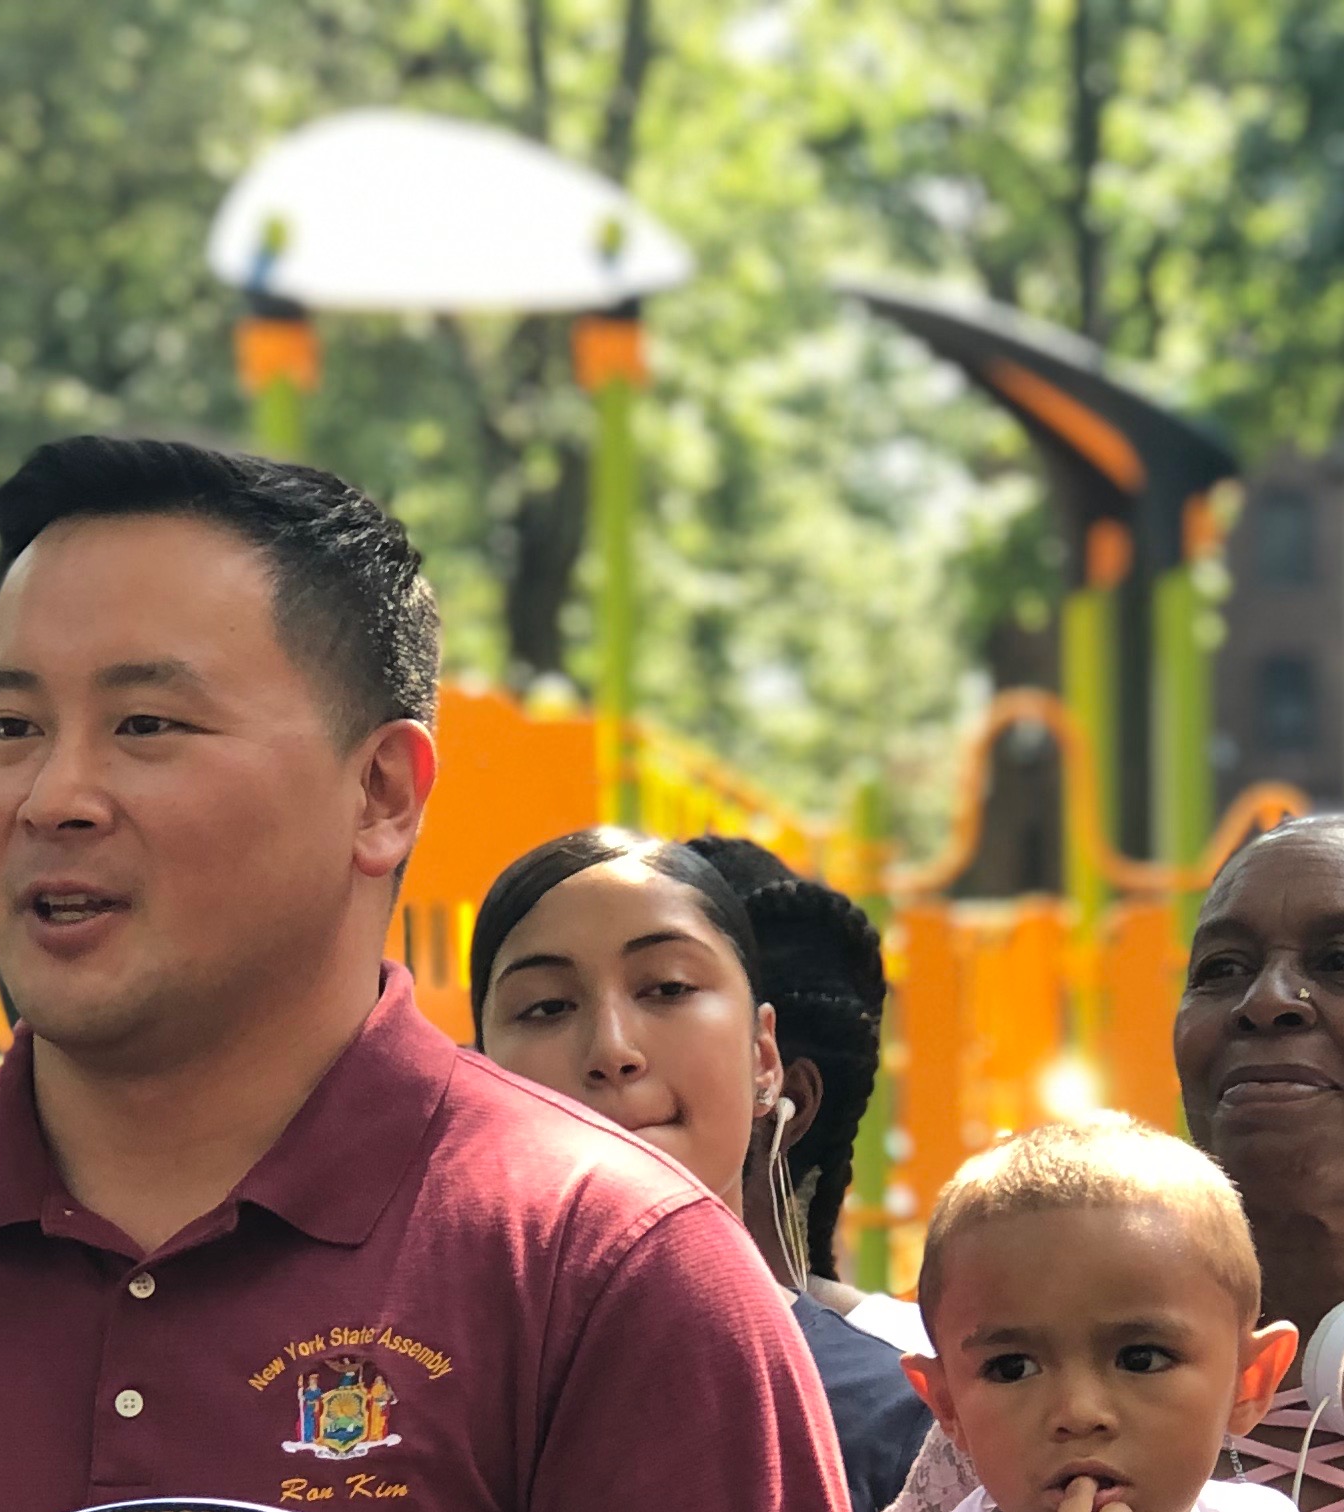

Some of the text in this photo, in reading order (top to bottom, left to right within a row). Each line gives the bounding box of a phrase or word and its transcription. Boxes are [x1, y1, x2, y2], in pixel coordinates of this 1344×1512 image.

[248, 1326, 453, 1391] New York State Assembly
[280, 1473, 408, 1502] Ron Kim
